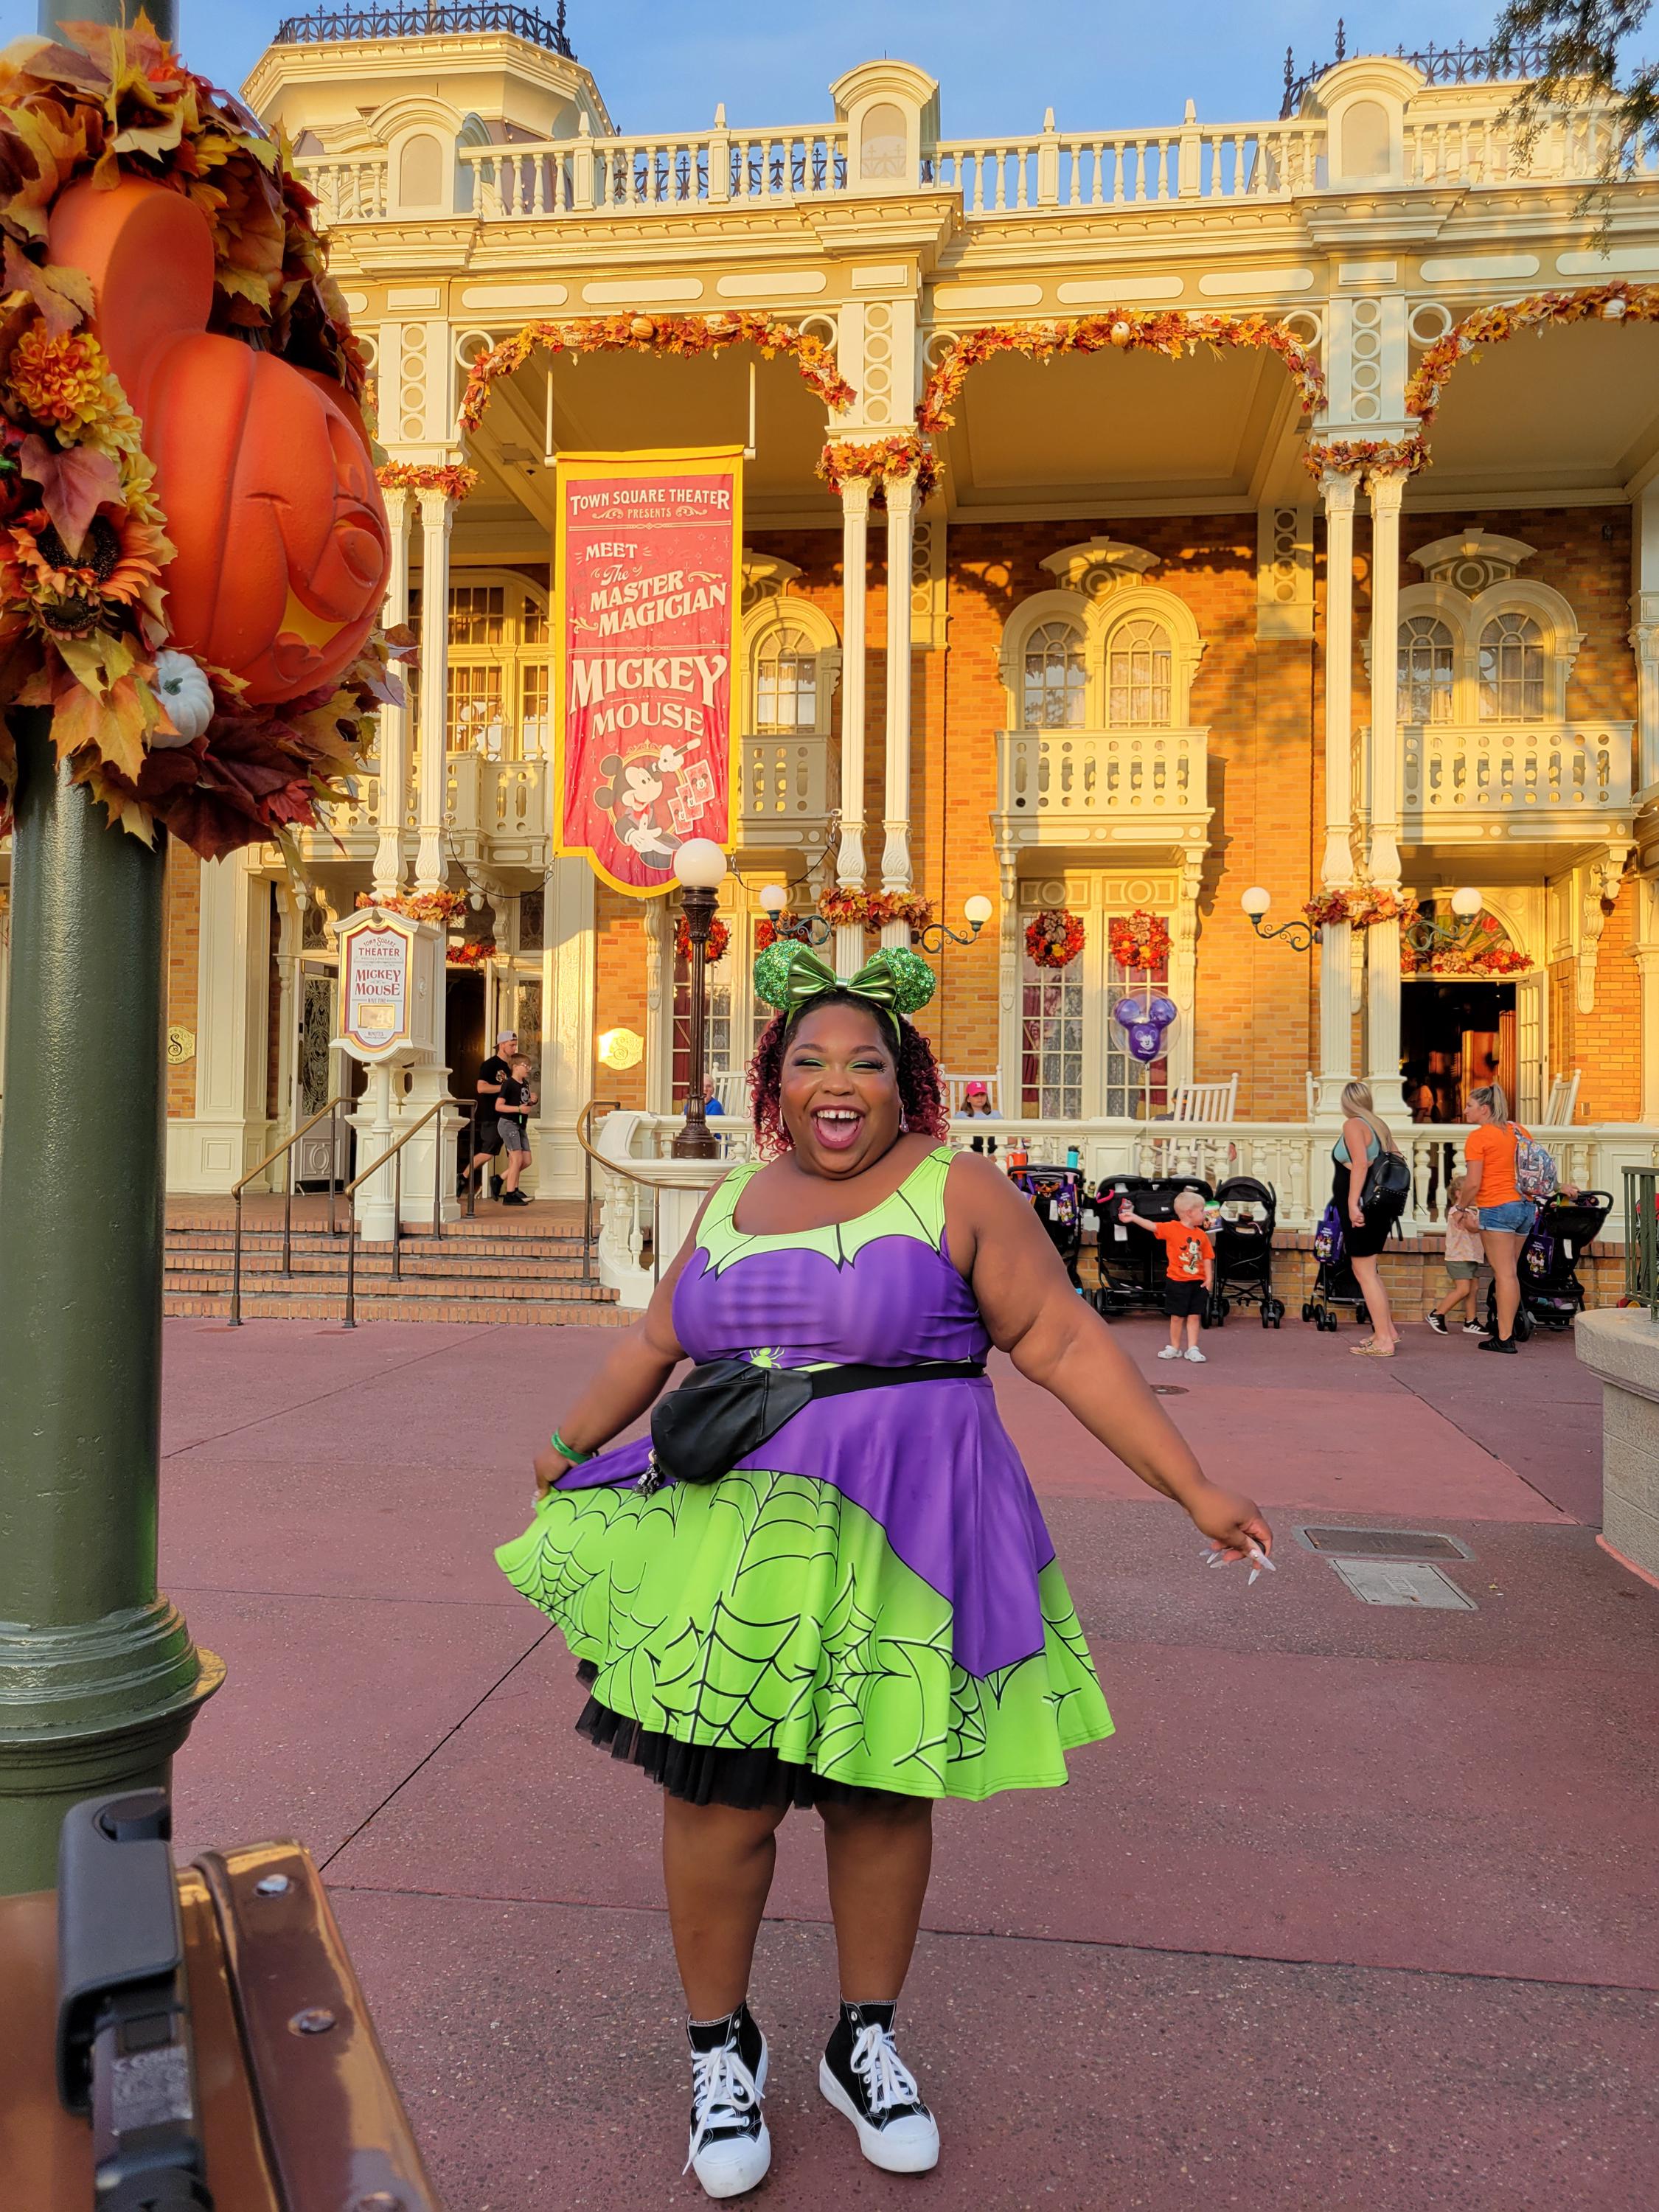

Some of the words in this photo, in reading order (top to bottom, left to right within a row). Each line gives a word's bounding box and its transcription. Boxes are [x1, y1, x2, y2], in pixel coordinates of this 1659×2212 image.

[570, 492, 609, 515] TOWN
[613, 489, 666, 505] SQUARE
[669, 489, 730, 510] THEATER
[627, 507, 672, 519] PRESENTS
[585, 542, 639, 562] MEET
[599, 564, 630, 586] The
[589, 570, 684, 613] MASTER
[598, 582, 727, 638] MAGICIAN
[568, 654, 728, 715] MICKEY
[591, 702, 705, 740] MOUSE
[358, 947, 400, 956] THEATER
[364, 938, 377, 947] TOWN
[377, 937, 396, 948] SQUARE
[355, 969, 401, 983] MICKEY
[355, 982, 400, 996] MOUSE
